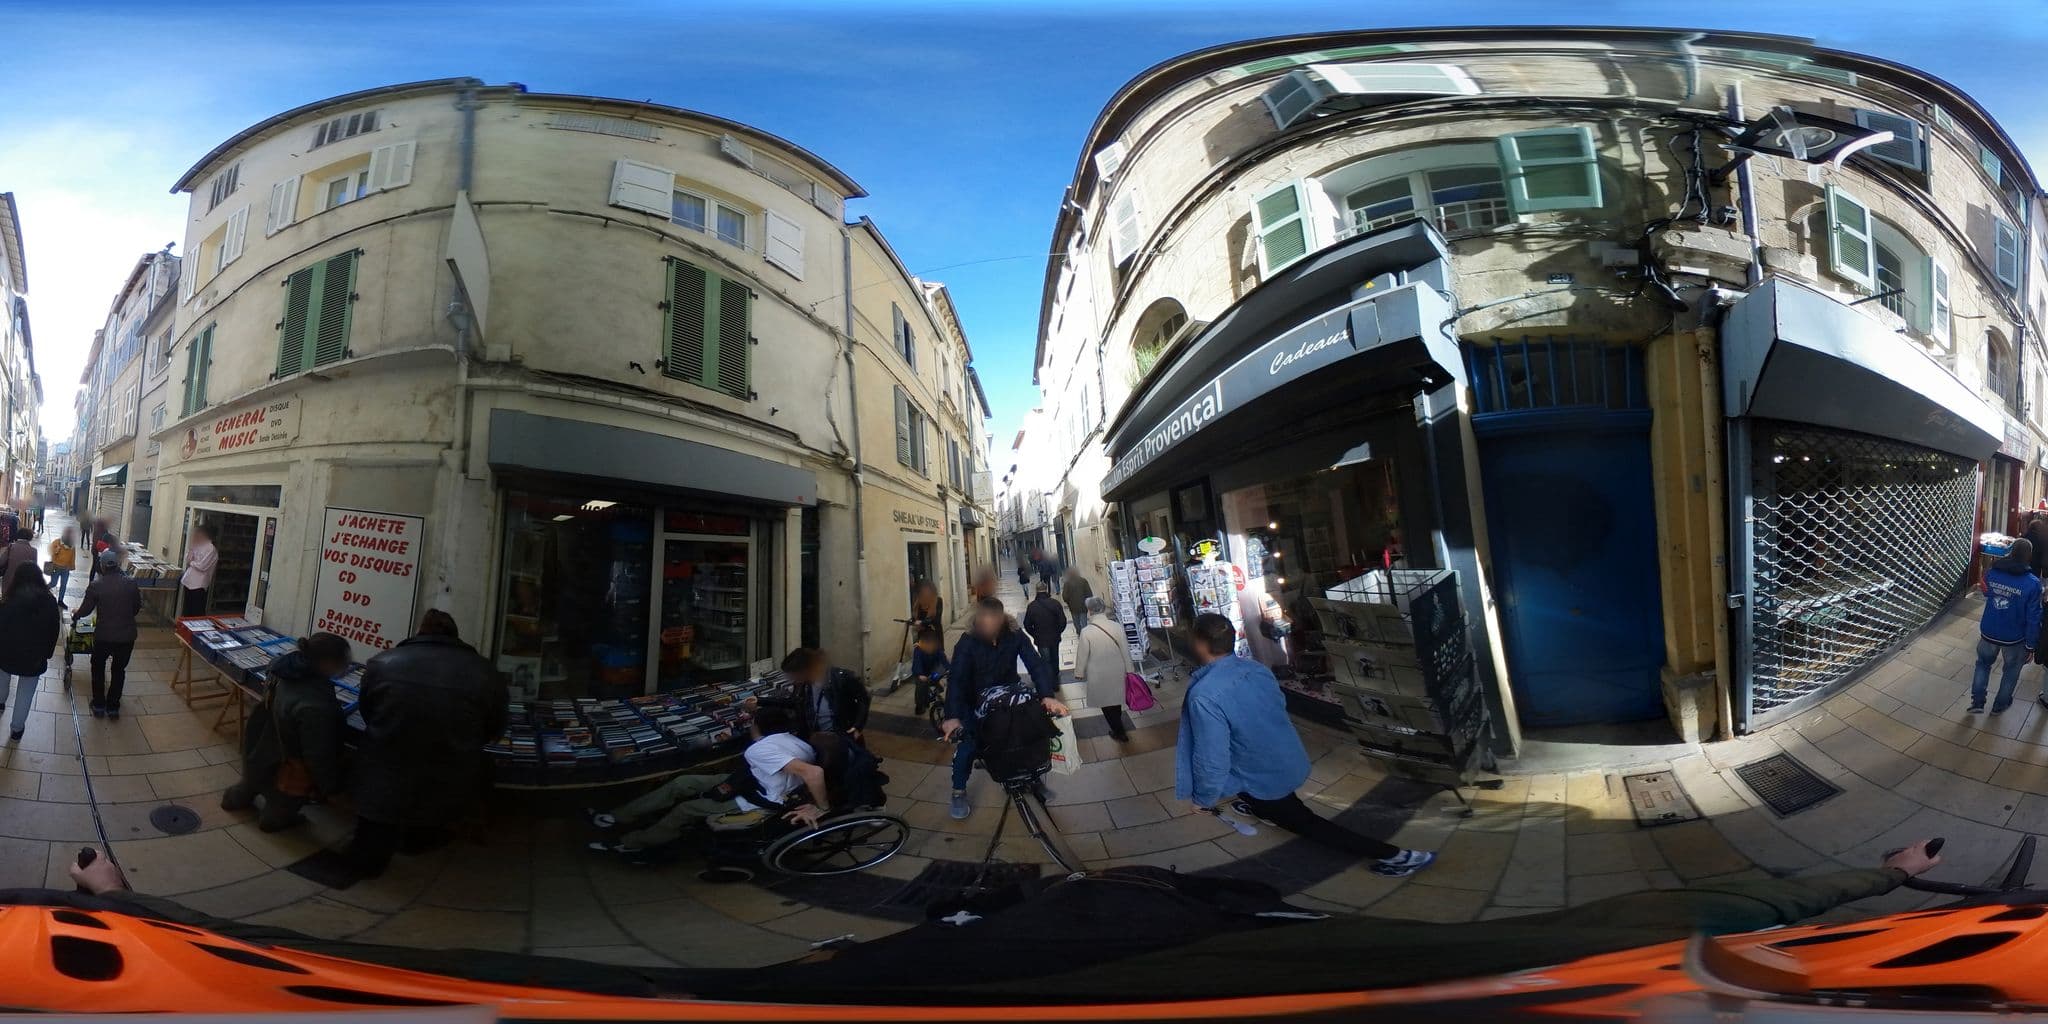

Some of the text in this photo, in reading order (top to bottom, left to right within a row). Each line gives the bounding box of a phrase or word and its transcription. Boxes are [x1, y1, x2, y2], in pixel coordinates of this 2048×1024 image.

[1269, 329, 1349, 375] Cadeaux
[269, 401, 289, 412] DISQUE
[215, 407, 266, 435] GENERAL
[270, 419, 282, 428] DVD
[1123, 447, 1144, 478] Esprit
[1144, 379, 1223, 460] Provençal
[218, 429, 258, 450] MUSIC
[338, 514, 406, 535] J'ACHETE
[331, 532, 409, 555] J'ECHANGE
[323, 548, 413, 577] VOS DISQUES
[338, 570, 357, 584] CD
[342, 590, 371, 607] DVD
[326, 608, 382, 634] BANDES
[317, 618, 393, 650] DESSINEES
